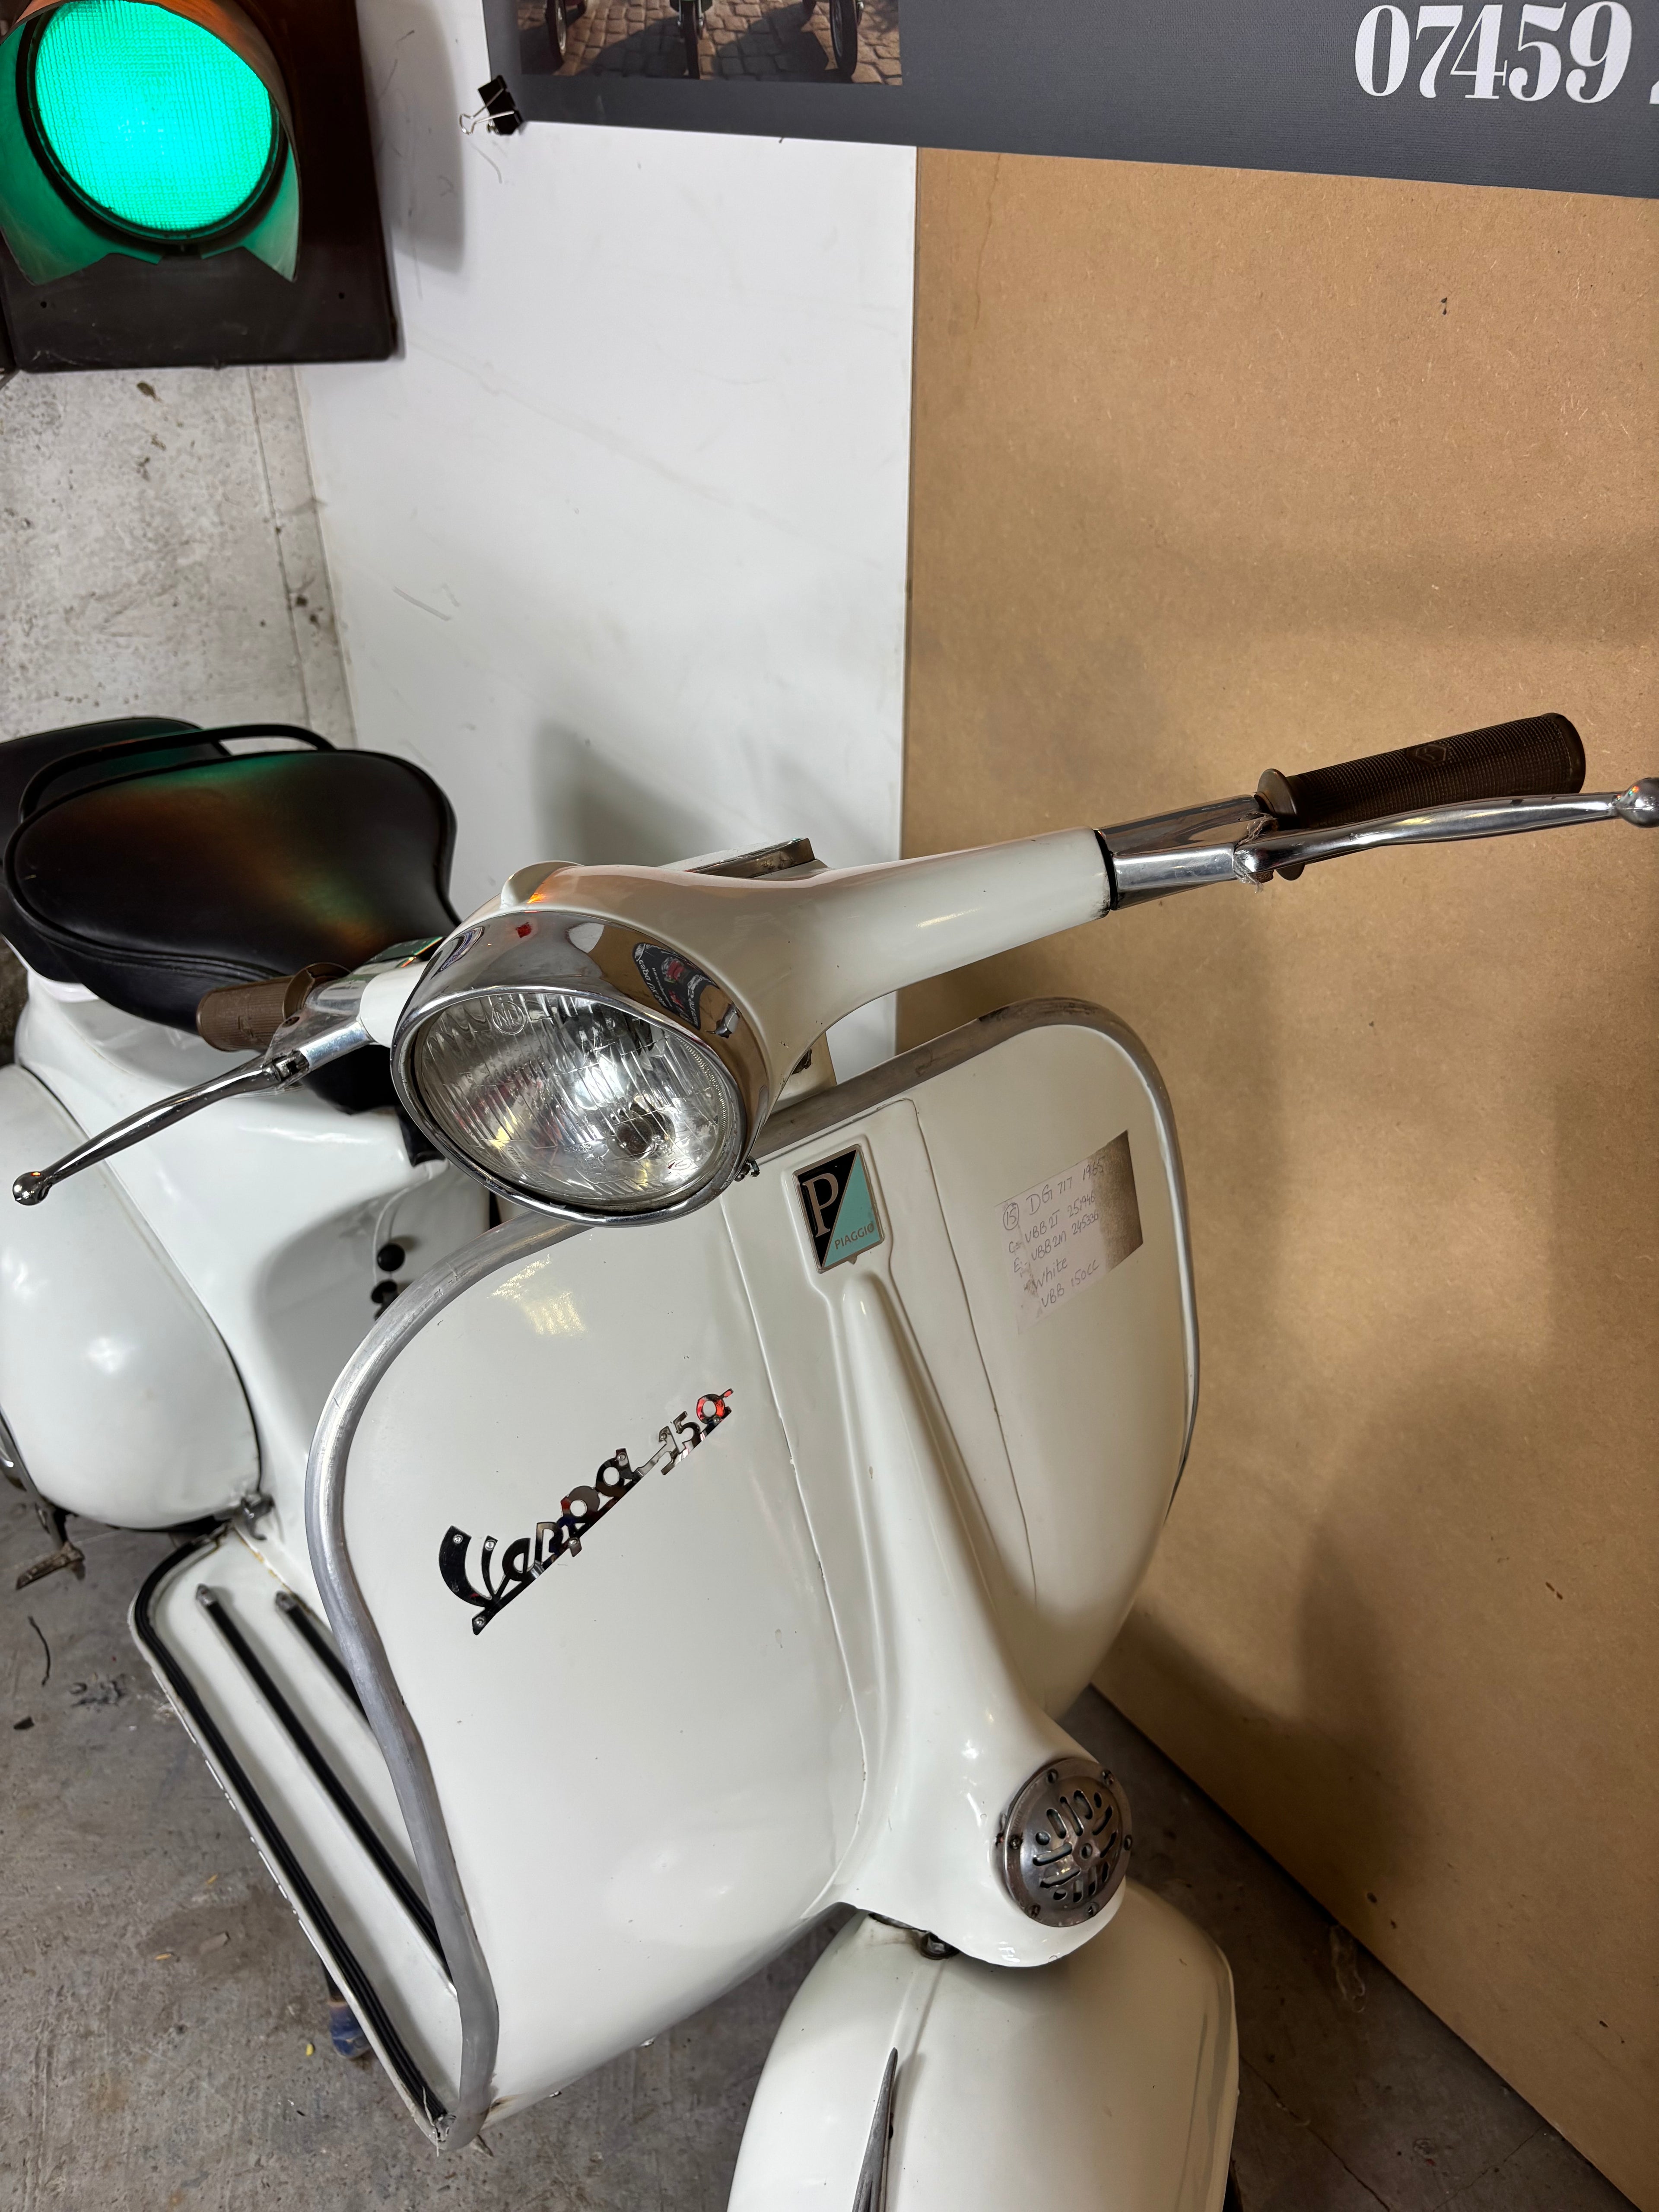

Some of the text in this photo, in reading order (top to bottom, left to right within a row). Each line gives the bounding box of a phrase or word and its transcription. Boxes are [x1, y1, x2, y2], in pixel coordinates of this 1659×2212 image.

[1355, 1, 1632, 103] 07459
[802, 1173, 839, 1238] P
[1058, 1176, 1072, 1194] 717
[1083, 1156, 1105, 1181] 1965
[834, 1222, 874, 1249] PIAGGIO
[439, 1388, 734, 1635] Vespa 150
